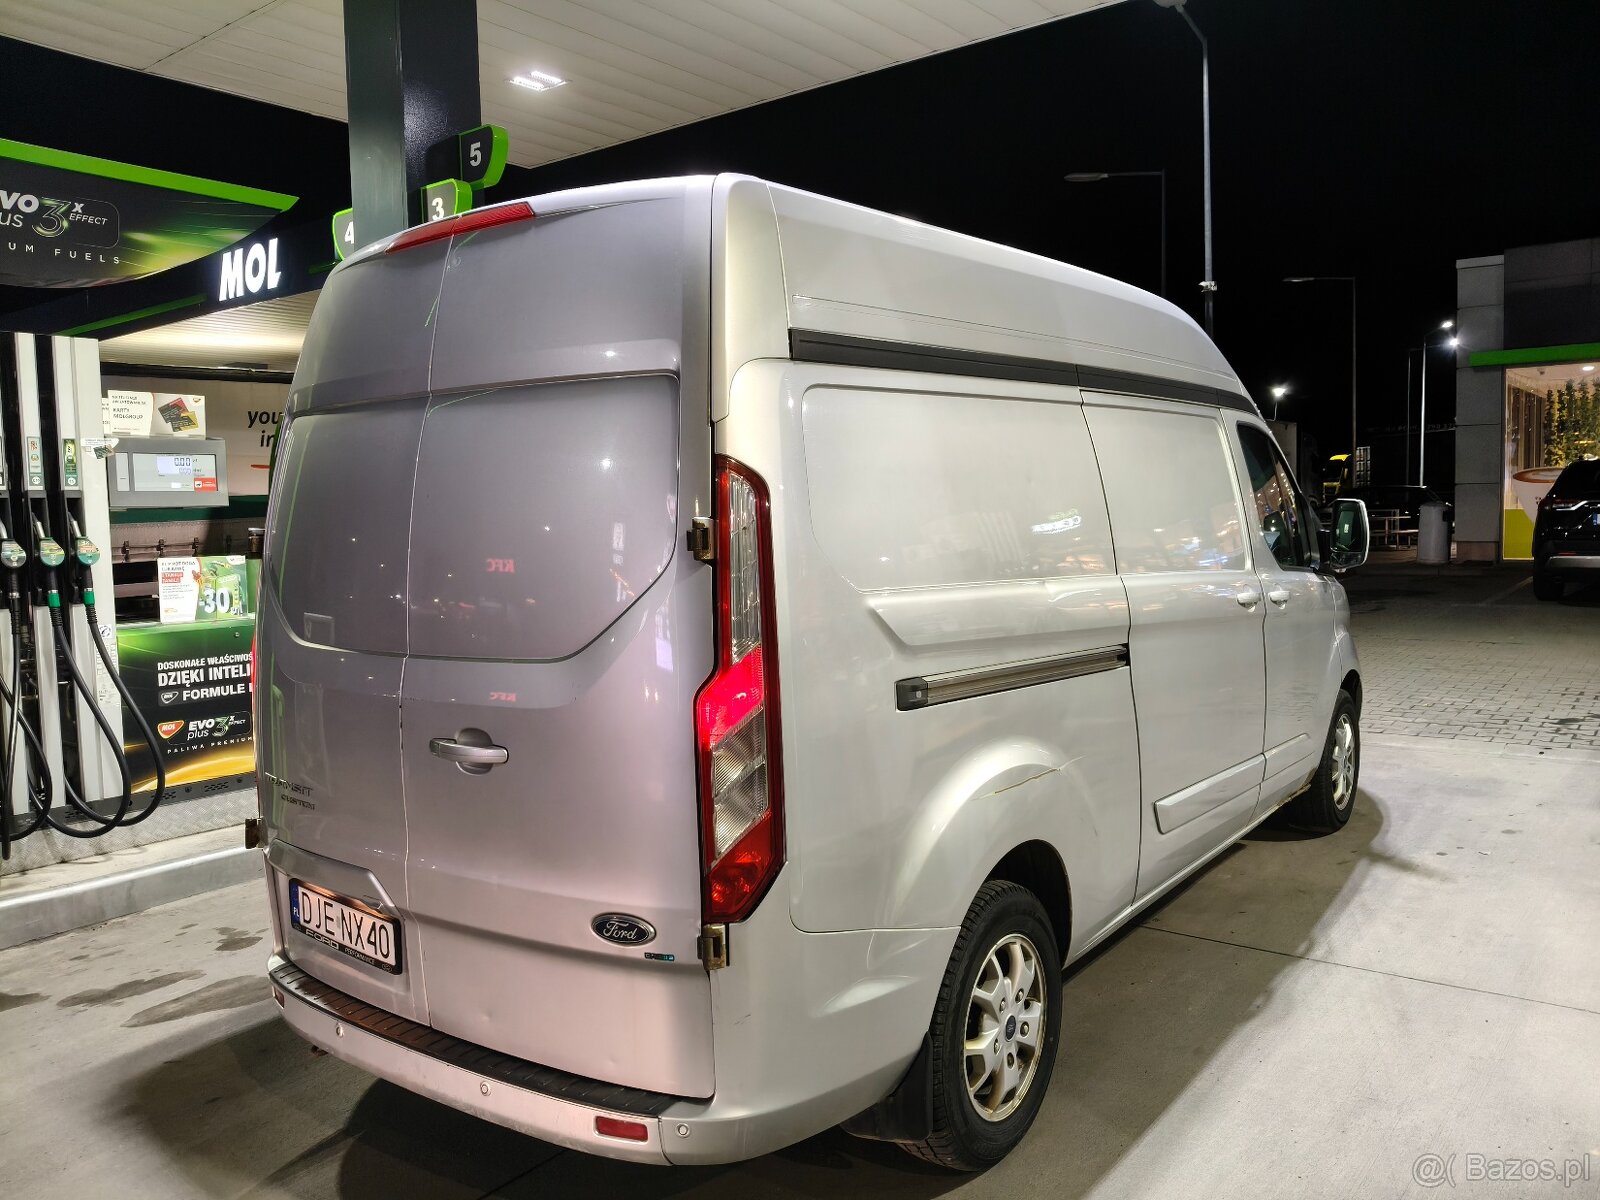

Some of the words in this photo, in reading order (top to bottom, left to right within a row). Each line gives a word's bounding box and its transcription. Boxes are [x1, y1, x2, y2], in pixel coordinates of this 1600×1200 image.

[469, 142, 482, 167] 5
[431, 197, 445, 221] 3
[69, 212, 108, 226] EFFECT
[344, 221, 355, 245] 4
[54, 248, 120, 265] FUELS
[218, 237, 282, 302] MOL
[247, 410, 282, 429] you
[157, 657, 206, 671] DOSKONAŁE
[158, 668, 205, 688] DZIĘKI
[208, 663, 251, 681] INTELI
[182, 683, 246, 701] FORMULE
[188, 718, 215, 731] EVO
[187, 729, 210, 741] plus
[167, 744, 205, 755] PALIWA
[210, 736, 253, 747] PREMIUM
[301, 891, 335, 936] DJE
[340, 907, 390, 960] NX40
[602, 920, 638, 940] Ford
[305, 928, 340, 950] FORD
